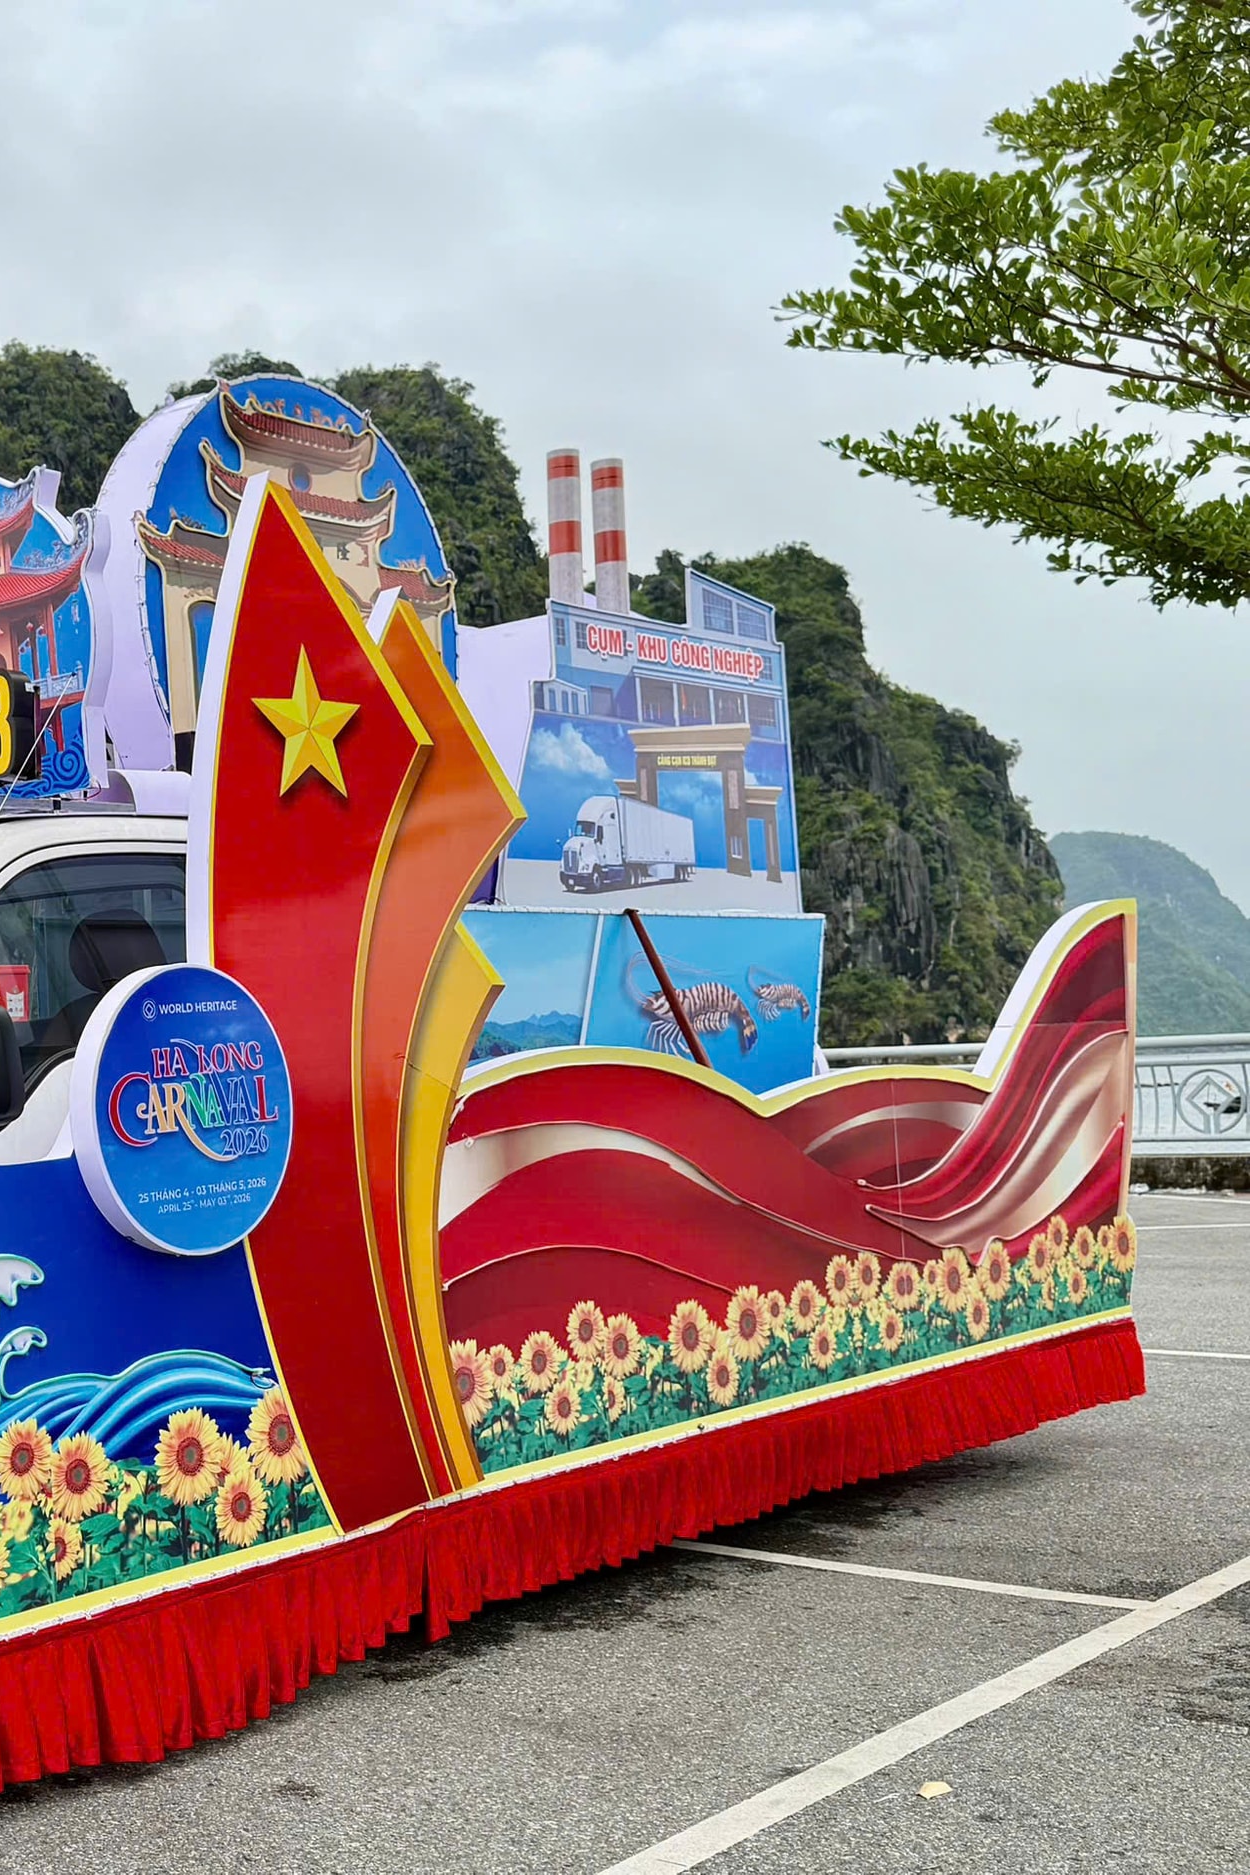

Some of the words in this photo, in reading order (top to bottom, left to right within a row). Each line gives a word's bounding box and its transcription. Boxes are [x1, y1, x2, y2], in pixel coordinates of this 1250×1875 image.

[587, 625, 623, 660] CỤM
[637, 634, 667, 664] KHU
[671, 637, 710, 670] CÔNG
[714, 648, 763, 684] NGHIỆP
[158, 1002, 192, 1015] WORLD
[195, 1000, 237, 1012] HERITAGE
[196, 1041, 263, 1075] LONG
[108, 1071, 279, 1161] CARNAVAL
[220, 1125, 269, 1156] 2026
[138, 1193, 149, 1203] 25
[150, 1188, 181, 1202] THÁNG
[183, 1188, 189, 1197] 4
[196, 1186, 206, 1195] 03
[208, 1180, 237, 1194] THÁNG
[247, 1177, 266, 1188] 2026
[158, 1203, 181, 1214] APRIL
[199, 1198, 216, 1208] MAY
[234, 1193, 251, 1204] 2026
